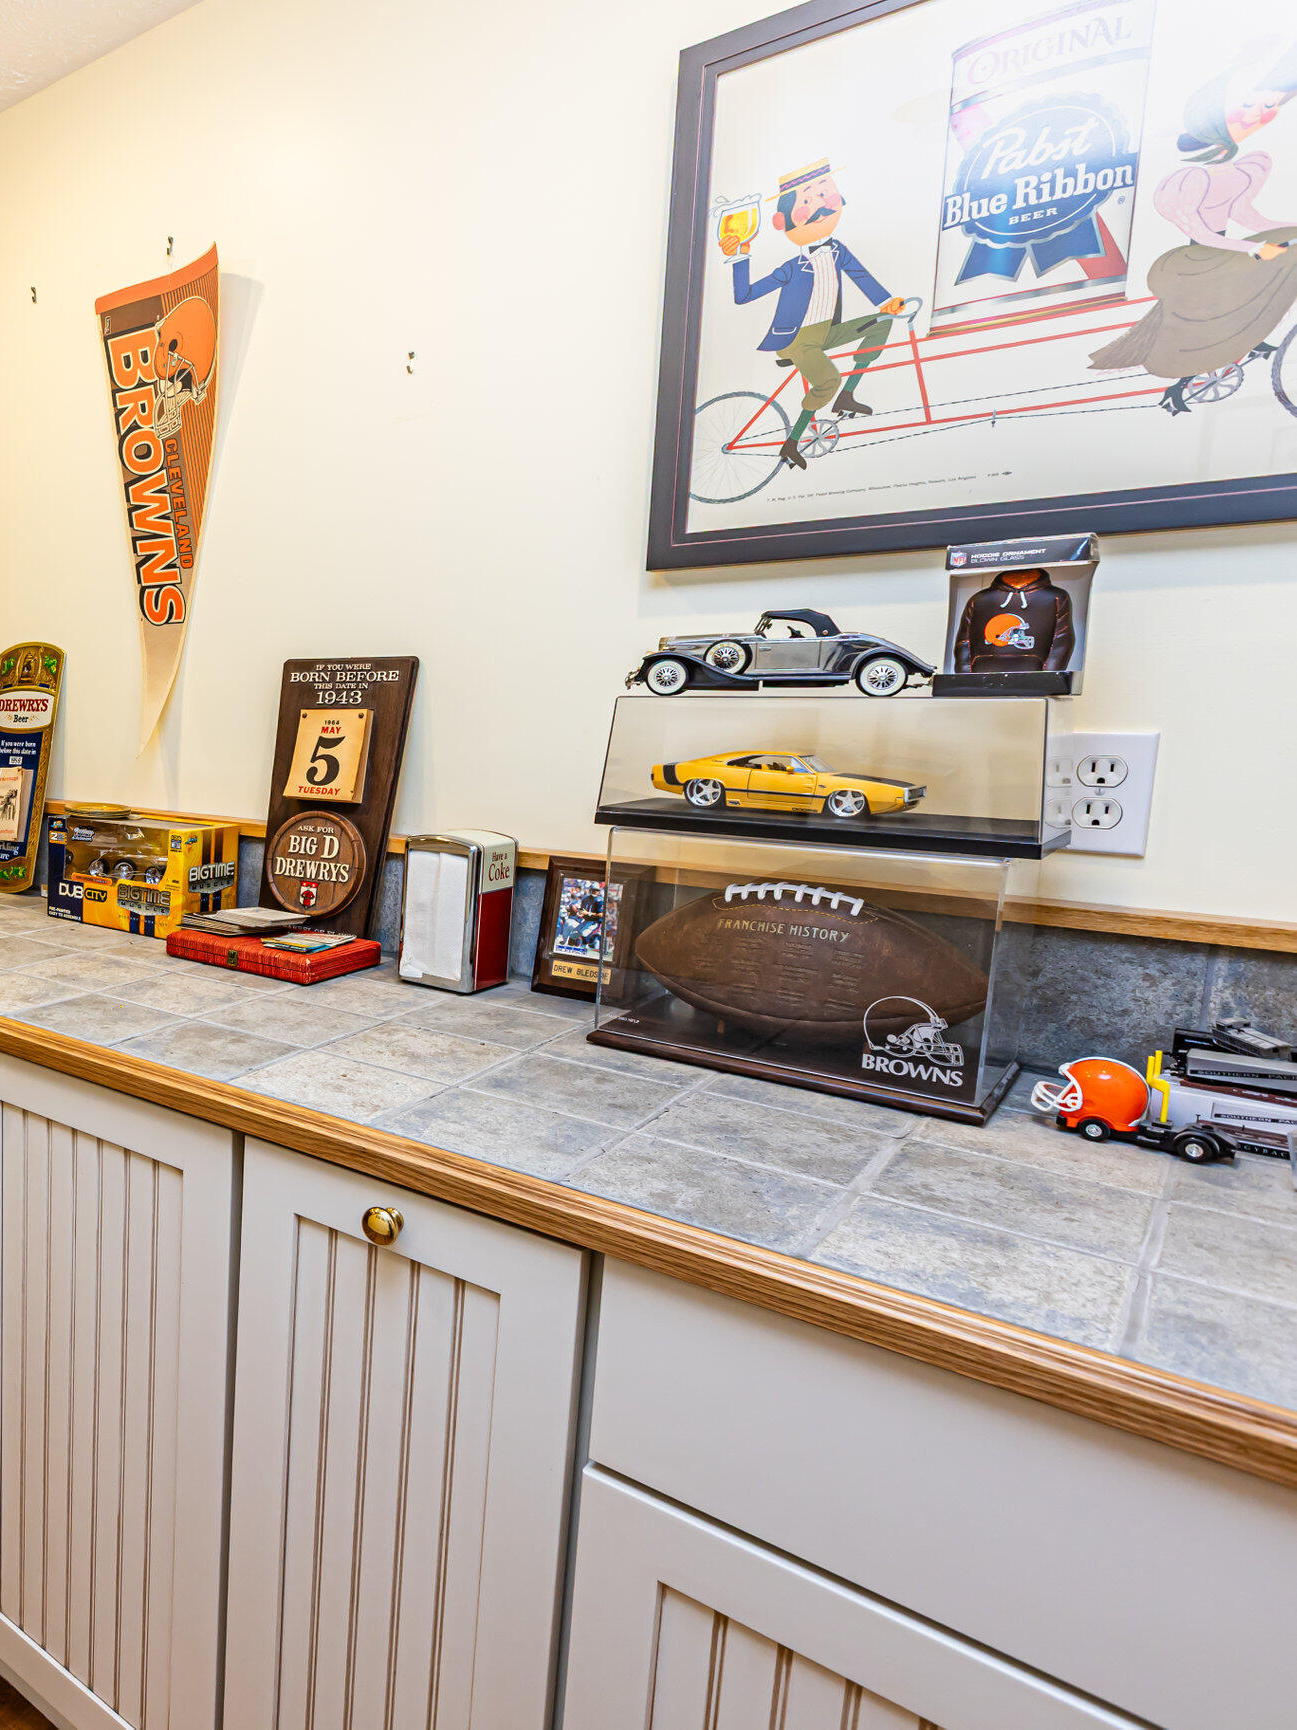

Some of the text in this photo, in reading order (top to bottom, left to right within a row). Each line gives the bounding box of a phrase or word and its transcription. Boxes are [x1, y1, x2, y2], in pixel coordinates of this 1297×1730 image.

[967, 16, 1133, 84] ORIGINAL
[980, 117, 1100, 180] Pabst
[944, 163, 1134, 228] Blue Ribbon
[1008, 207, 1059, 226] BEER
[106, 325, 188, 627] BROWNS
[165, 438, 194, 570] CLEVELAND
[1002, 548, 1047, 556] ORNAMENT
[290, 670, 399, 683] BORN BEFORE
[327, 663, 344, 671] YOU
[315, 690, 363, 705] 1943
[13, 714, 29, 722] Beer
[320, 726, 342, 734] MAY
[305, 735, 346, 786] 5
[298, 786, 341, 796] TUESDAY
[317, 826, 334, 834] FOR
[288, 835, 340, 859] BIG D
[492, 851, 504, 861] Have
[188, 861, 235, 882] BIGTIME
[274, 856, 350, 883] DREWRYS
[488, 862, 510, 881] Coke
[58, 882, 107, 902] DUB CITY
[117, 883, 171, 906] BIGTIME
[716, 918, 851, 943] FRANCHISE HISTORY
[553, 964, 573, 974] DREW
[861, 1053, 963, 1087] BROWNS
[1198, 1070, 1260, 1079] SOUTHERN
[1220, 1113, 1272, 1123] SOUTHERN
